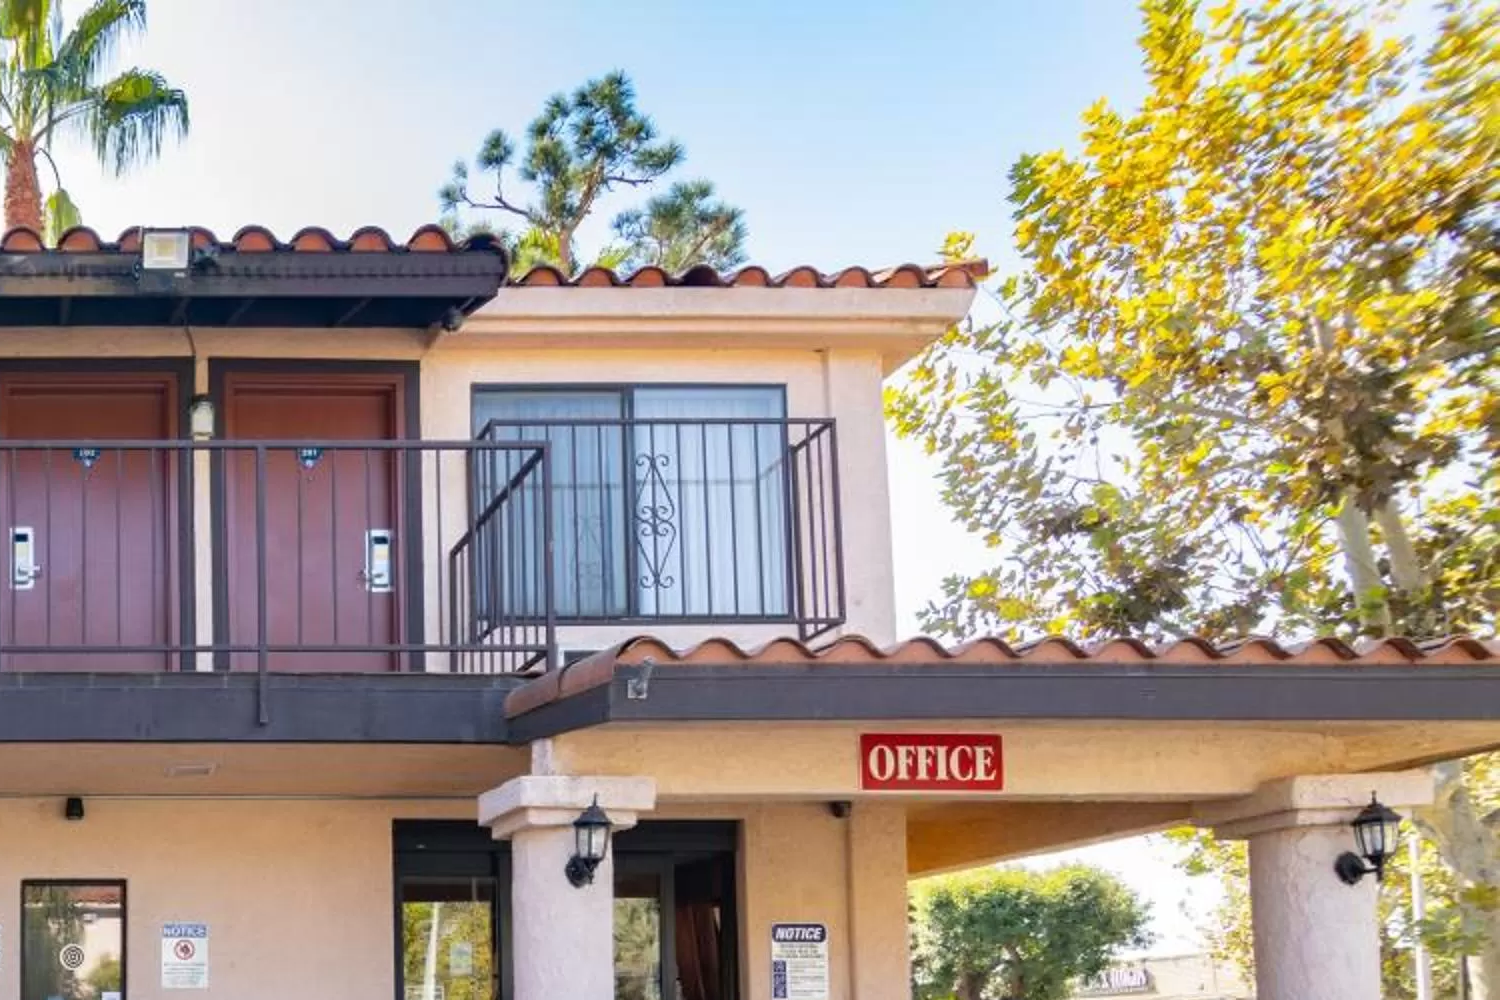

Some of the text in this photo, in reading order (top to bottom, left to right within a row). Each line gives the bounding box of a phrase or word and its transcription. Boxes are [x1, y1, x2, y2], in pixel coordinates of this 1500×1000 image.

[869, 744, 997, 781] OFFICE
[164, 926, 205, 937] NOTICE
[775, 927, 824, 940] NOTICE
